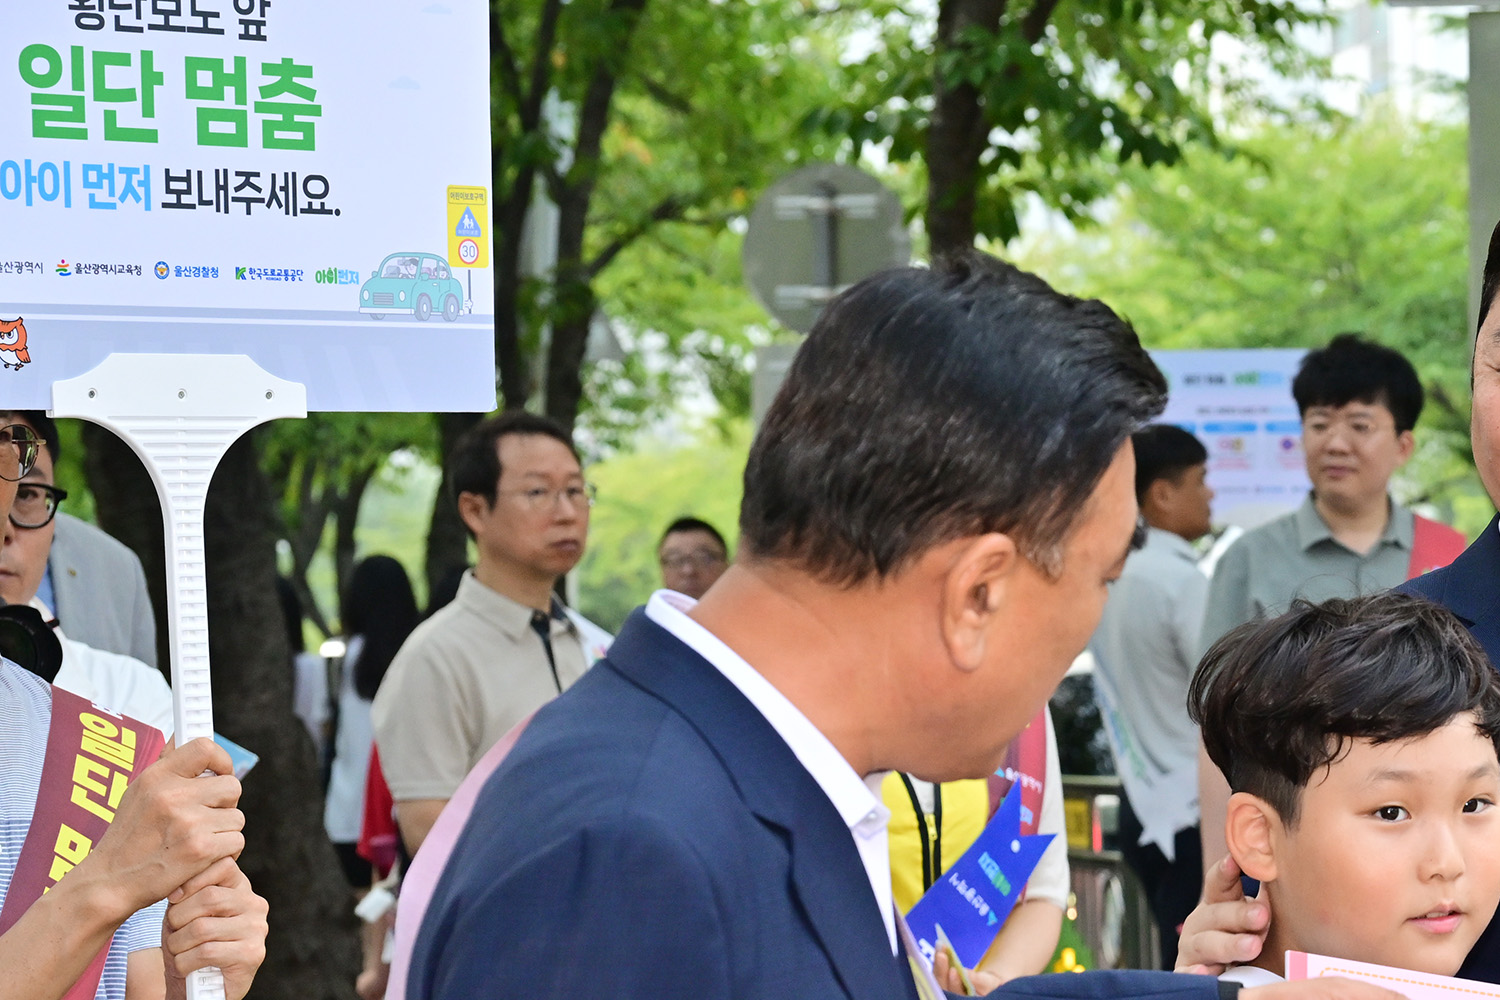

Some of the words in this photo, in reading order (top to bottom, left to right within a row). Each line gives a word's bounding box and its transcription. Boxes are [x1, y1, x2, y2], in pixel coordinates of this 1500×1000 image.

[233, 0, 271, 41] 앞
[18, 43, 164, 143] 일단
[185, 56, 322, 151] 멈춤
[0, 159, 71, 208] 아이
[82, 163, 152, 211] 먼저
[161, 168, 341, 217] 보내주세요.
[462, 245, 476, 258] 30
[74, 262, 142, 276] 울산광역시교육청
[174, 265, 219, 278] 울산경찰청
[248, 267, 304, 281] 한국도로교통공단
[71, 712, 137, 824] 일단
